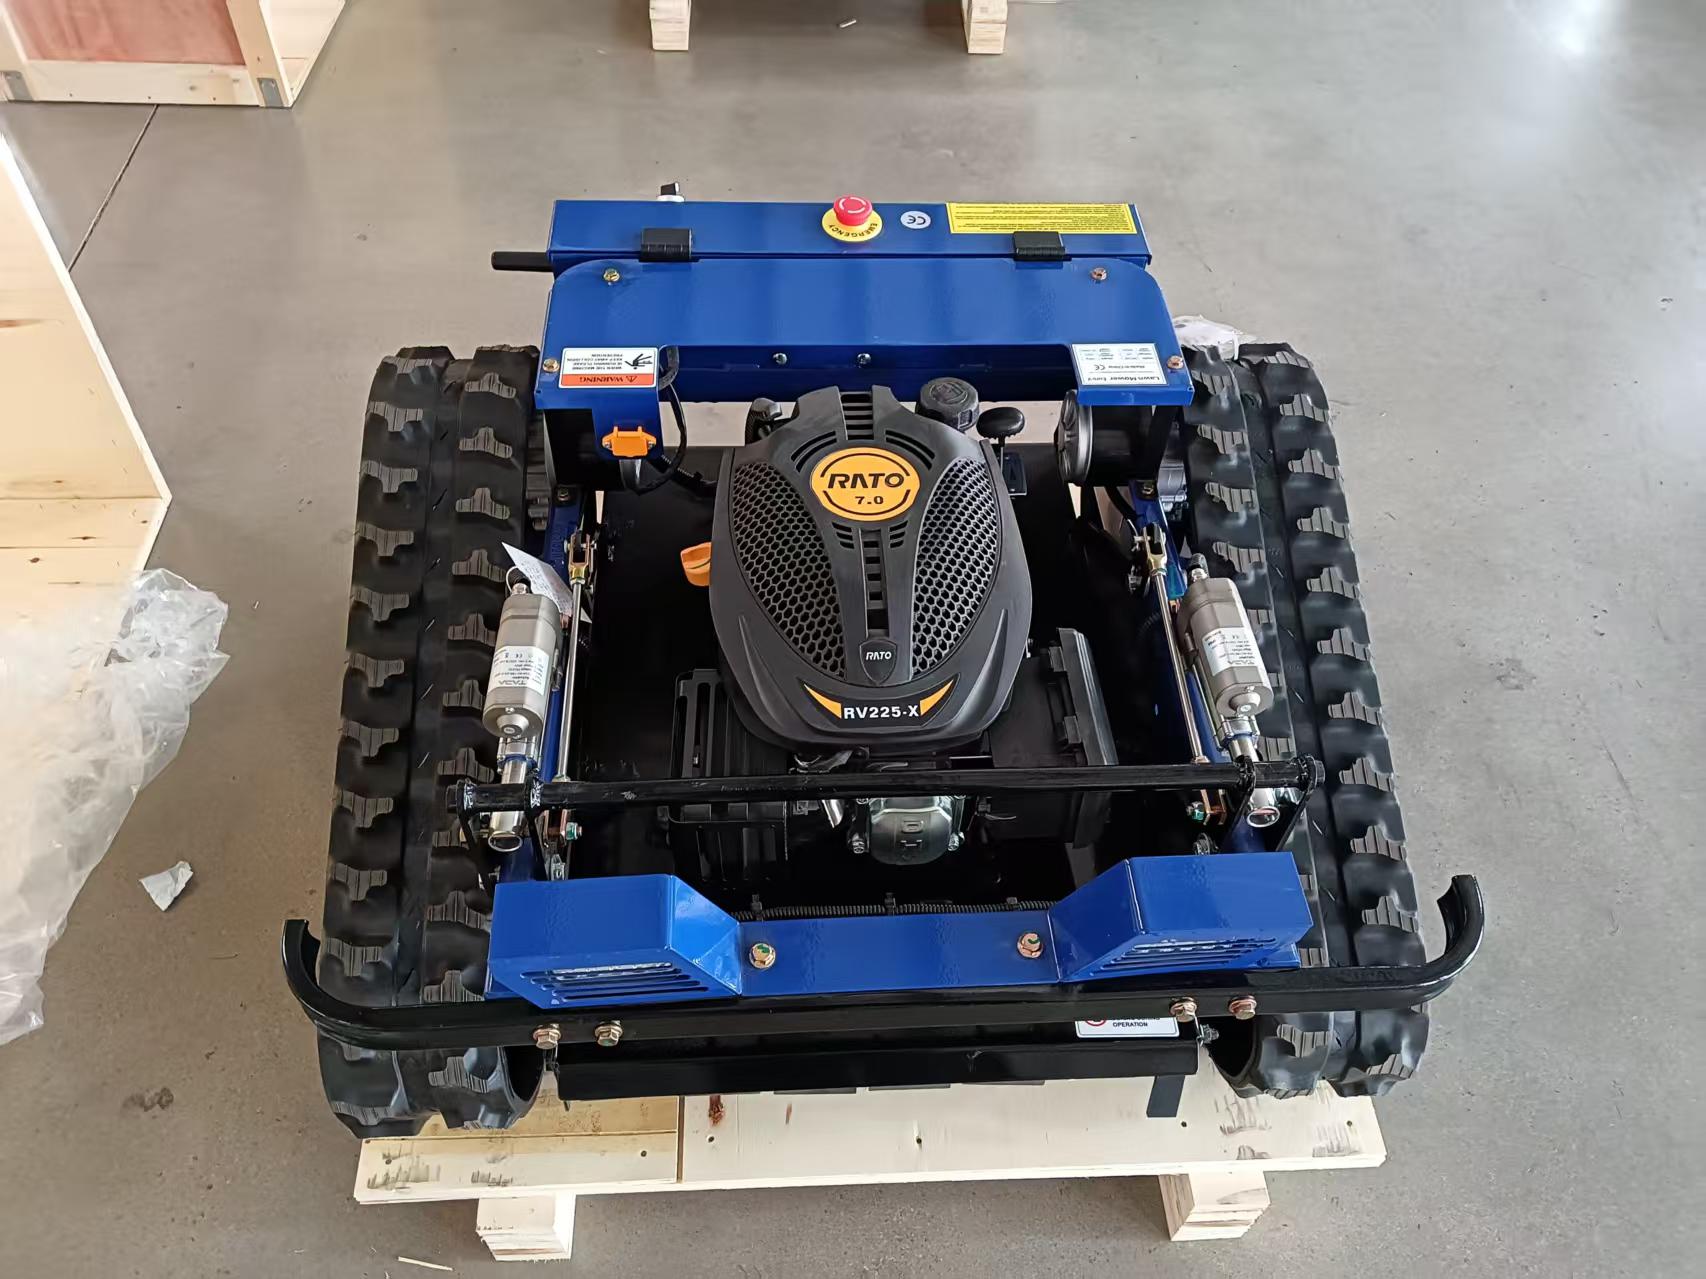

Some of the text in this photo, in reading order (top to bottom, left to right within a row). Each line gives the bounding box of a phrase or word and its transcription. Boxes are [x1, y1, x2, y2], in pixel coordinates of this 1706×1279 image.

[828, 222, 878, 238] EMERGENCY
[827, 472, 905, 489] RATO
[855, 495, 884, 505] 7.0
[865, 651, 892, 661] RATO
[843, 704, 919, 719] RV225-X
